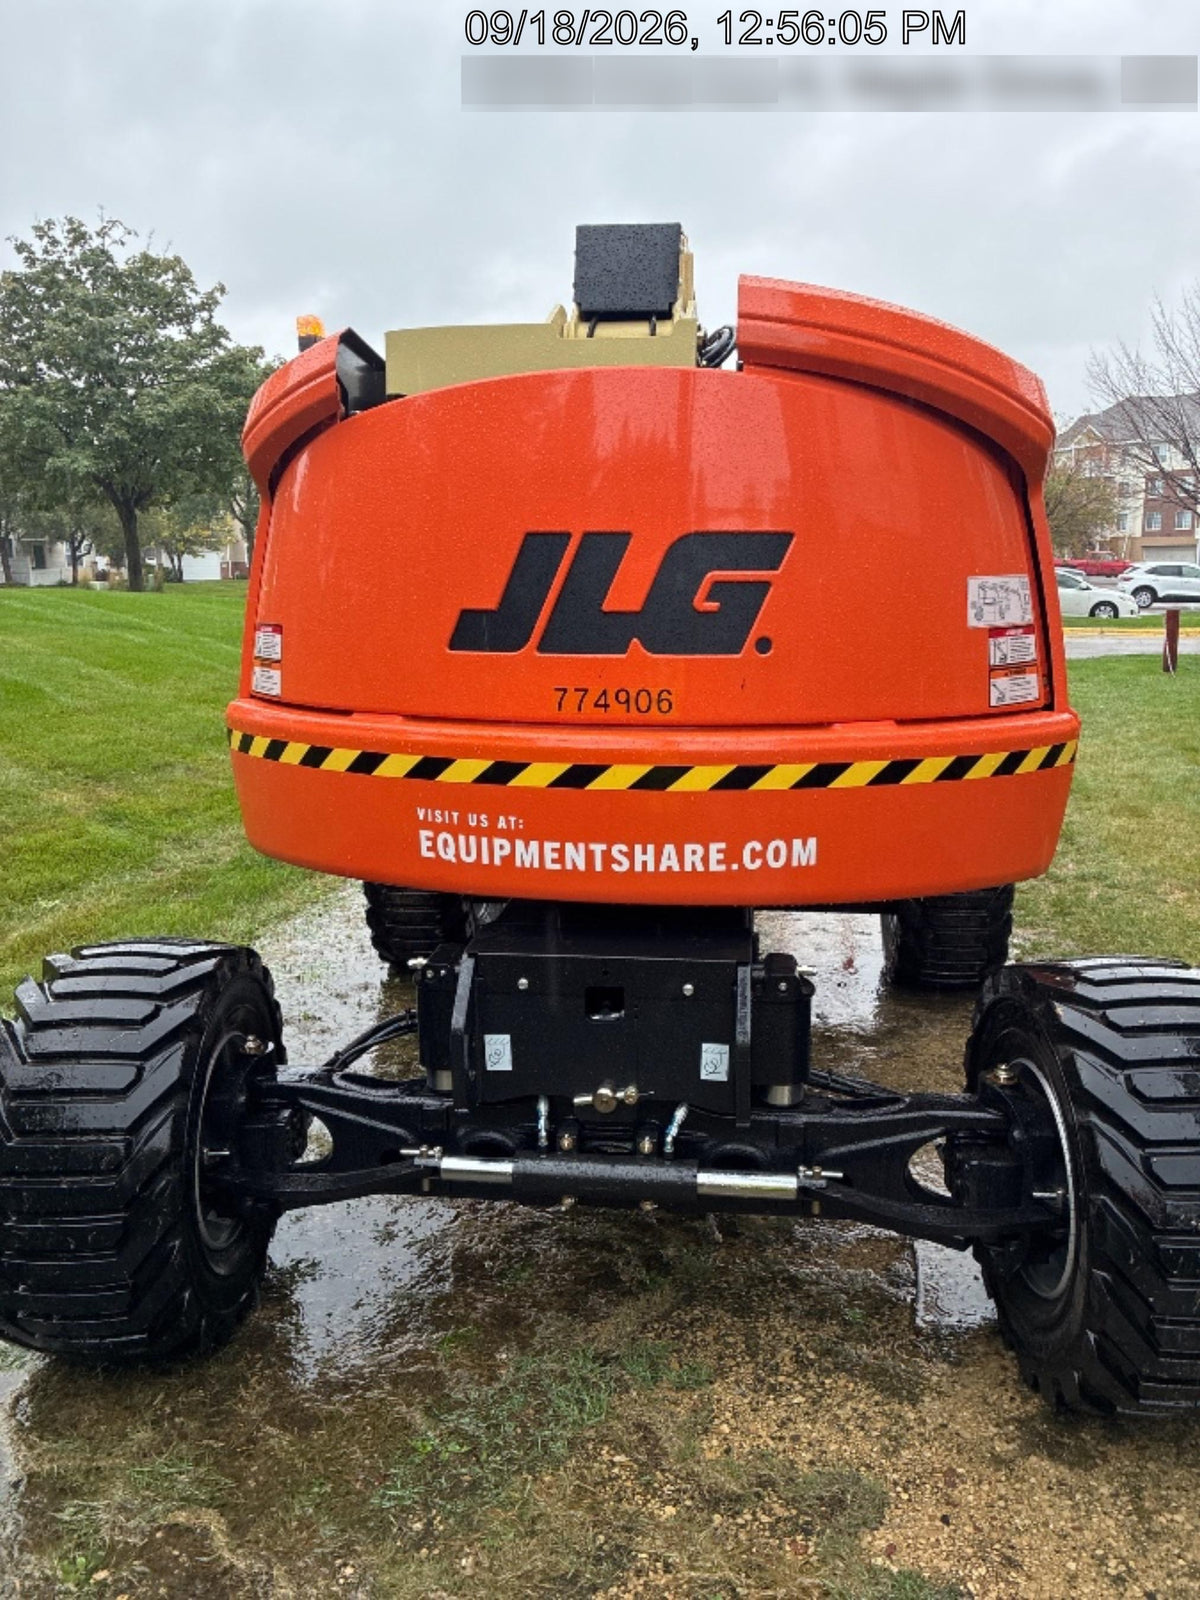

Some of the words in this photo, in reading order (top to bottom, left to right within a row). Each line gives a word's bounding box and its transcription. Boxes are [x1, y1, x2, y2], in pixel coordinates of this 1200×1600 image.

[554, 687, 674, 714] 774906
[416, 807, 460, 826] VISIT
[468, 812, 489, 828] US
[497, 815, 524, 830] AT:
[418, 829, 818, 873] EQUIPMENTSHARE.COM
